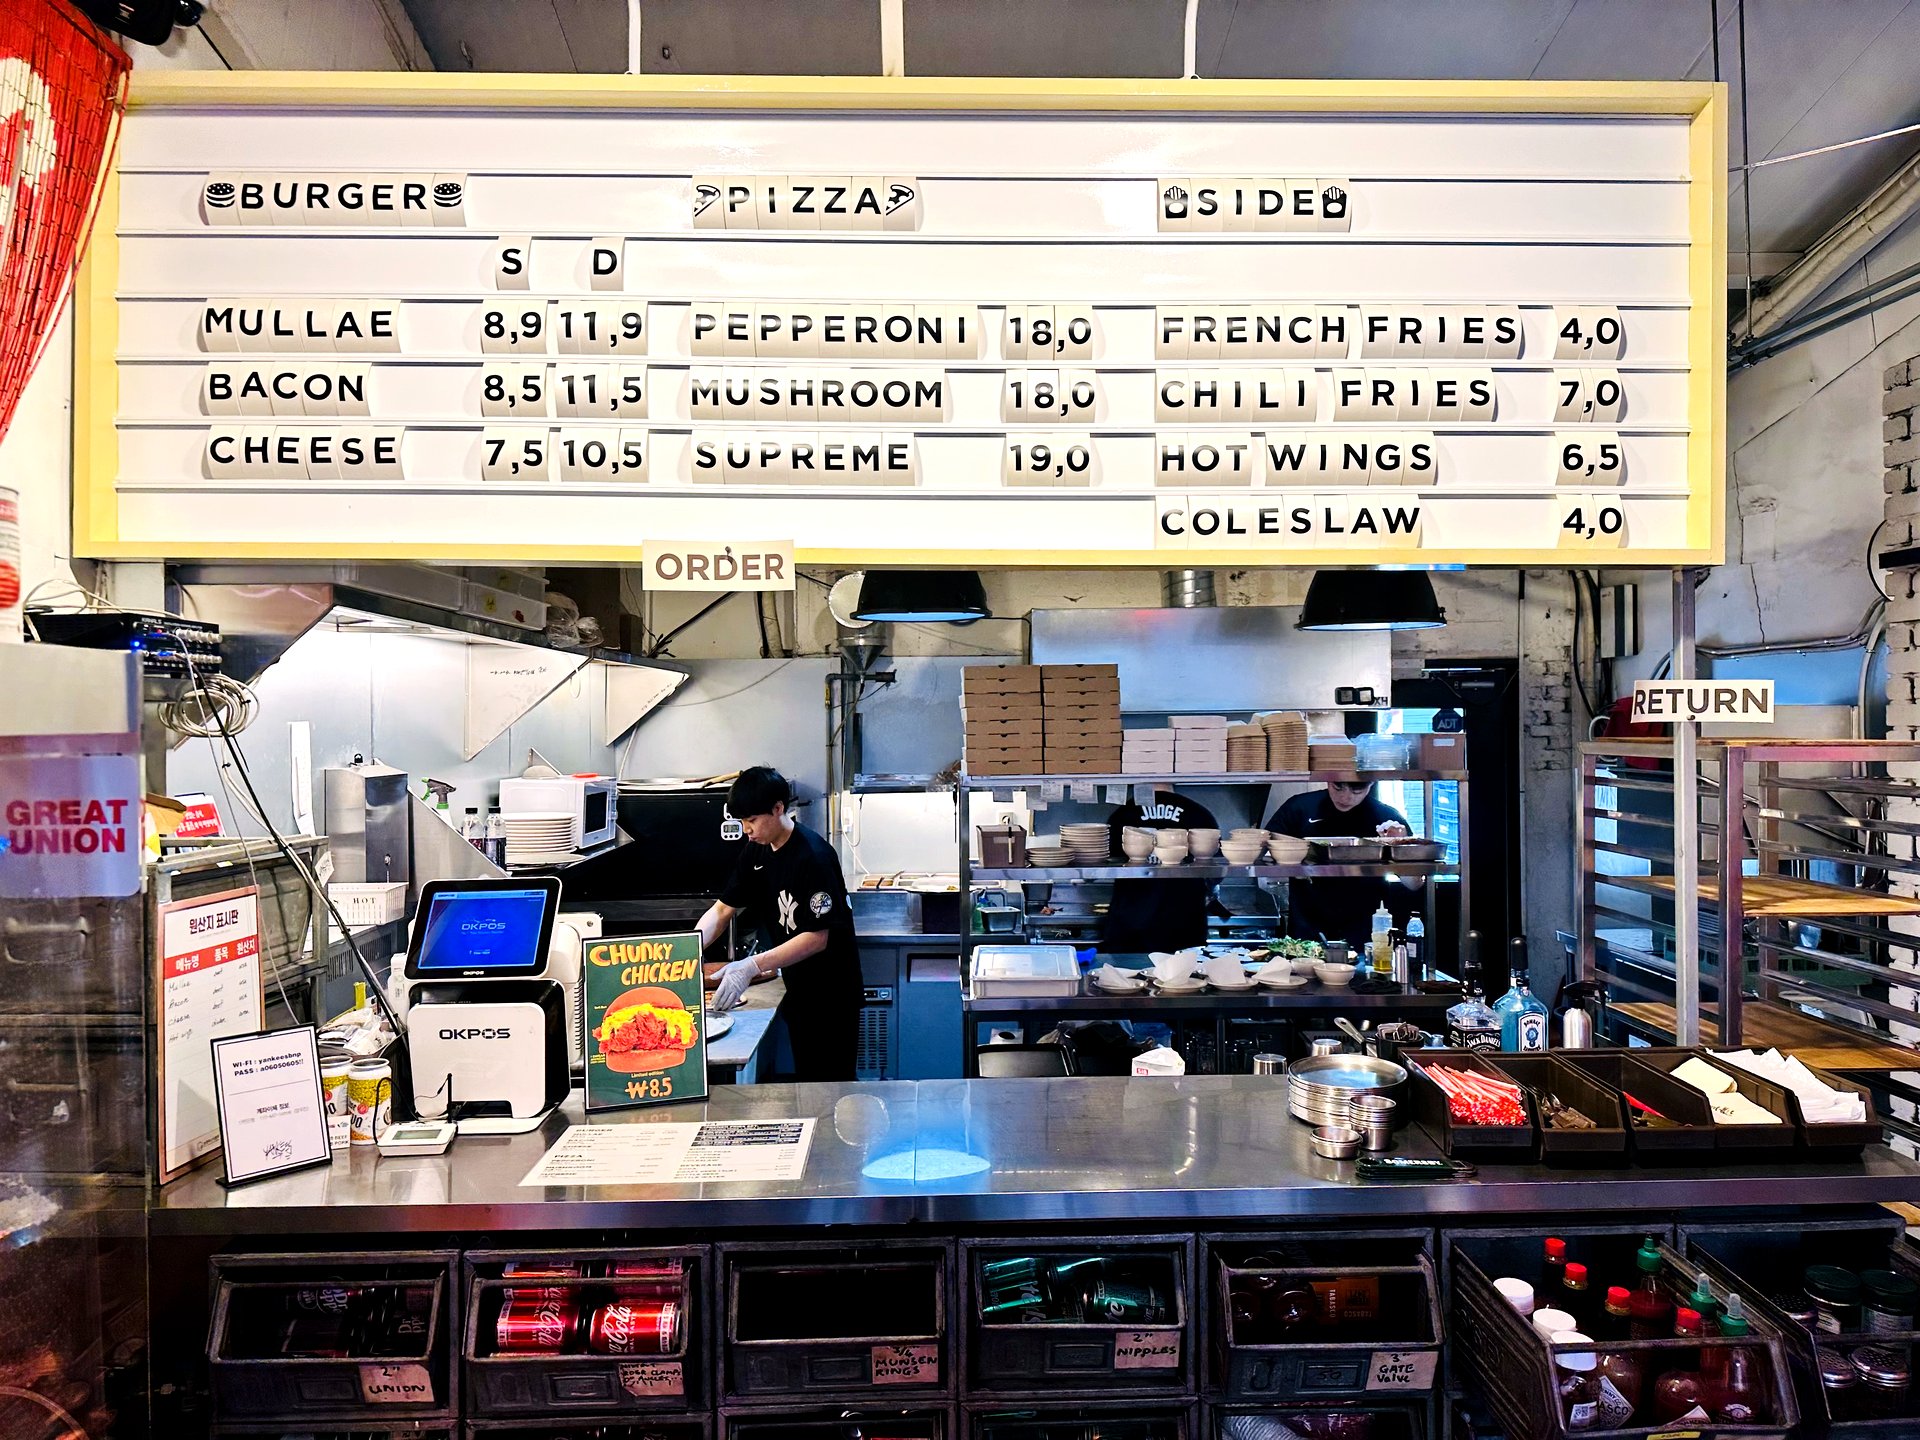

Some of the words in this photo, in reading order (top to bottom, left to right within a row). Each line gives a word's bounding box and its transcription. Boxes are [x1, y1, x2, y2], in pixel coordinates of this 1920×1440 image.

[242, 183, 426, 210] BURGER
[729, 187, 881, 214] PIZZA
[1198, 189, 1313, 215] SIDE
[502, 249, 522, 274] S
[594, 249, 617, 275] D
[206, 308, 392, 338] MULLAE
[485, 312, 541, 344] 8,9
[561, 312, 641, 347] 11,9
[696, 314, 964, 343] PEPPERONI
[1010, 318, 1091, 352] 18,0
[1164, 316, 1344, 343] FRENCH
[1368, 317, 1515, 343] FRIES
[1560, 318, 1621, 350] 4,0
[210, 372, 363, 401] BACON
[485, 375, 541, 407] 8,5
[562, 375, 641, 411] 11,5
[692, 379, 941, 407] MUSHROOM
[1011, 382, 1094, 416] 18,0
[1162, 381, 1304, 408] CHILI
[1342, 380, 1490, 406] FRIES
[1561, 380, 1621, 414] 7,0
[210, 437, 396, 465] CHEESE
[486, 440, 542, 474] 7,5
[564, 441, 641, 474] 10,5
[696, 444, 908, 471] SUPREME
[1011, 445, 1089, 477] 19,0
[1162, 446, 1247, 471] HOT
[1268, 444, 1431, 470] WINGS
[1563, 444, 1618, 476] 6,5
[1162, 508, 1420, 535] COLESLAW
[1563, 508, 1622, 539] 4,0
[655, 553, 785, 581] ORDER
[1633, 688, 1768, 715] RETURN
[1438, 719, 1458, 729] ADT
[6, 799, 128, 826] GREAT
[1141, 803, 1184, 823] JUDGE
[9, 828, 125, 855] UNION
[189, 915, 215, 935] 원산지
[216, 909, 239, 928] 표시판
[461, 922, 506, 931] OKPOS
[589, 941, 673, 967] CHUNKY
[621, 959, 698, 986] CHICKEN
[439, 1028, 511, 1040] OKPOS
[1467, 1038, 1480, 1048] JACK
[234, 1068, 254, 1076] PASS
[1328, 1289, 1337, 1318] TABASCO
[1116, 1346, 1177, 1357] NIPPLES
[875, 1366, 920, 1377] RINGS
[1379, 1364, 1415, 1374] GATE
[368, 1384, 425, 1394] UNION
